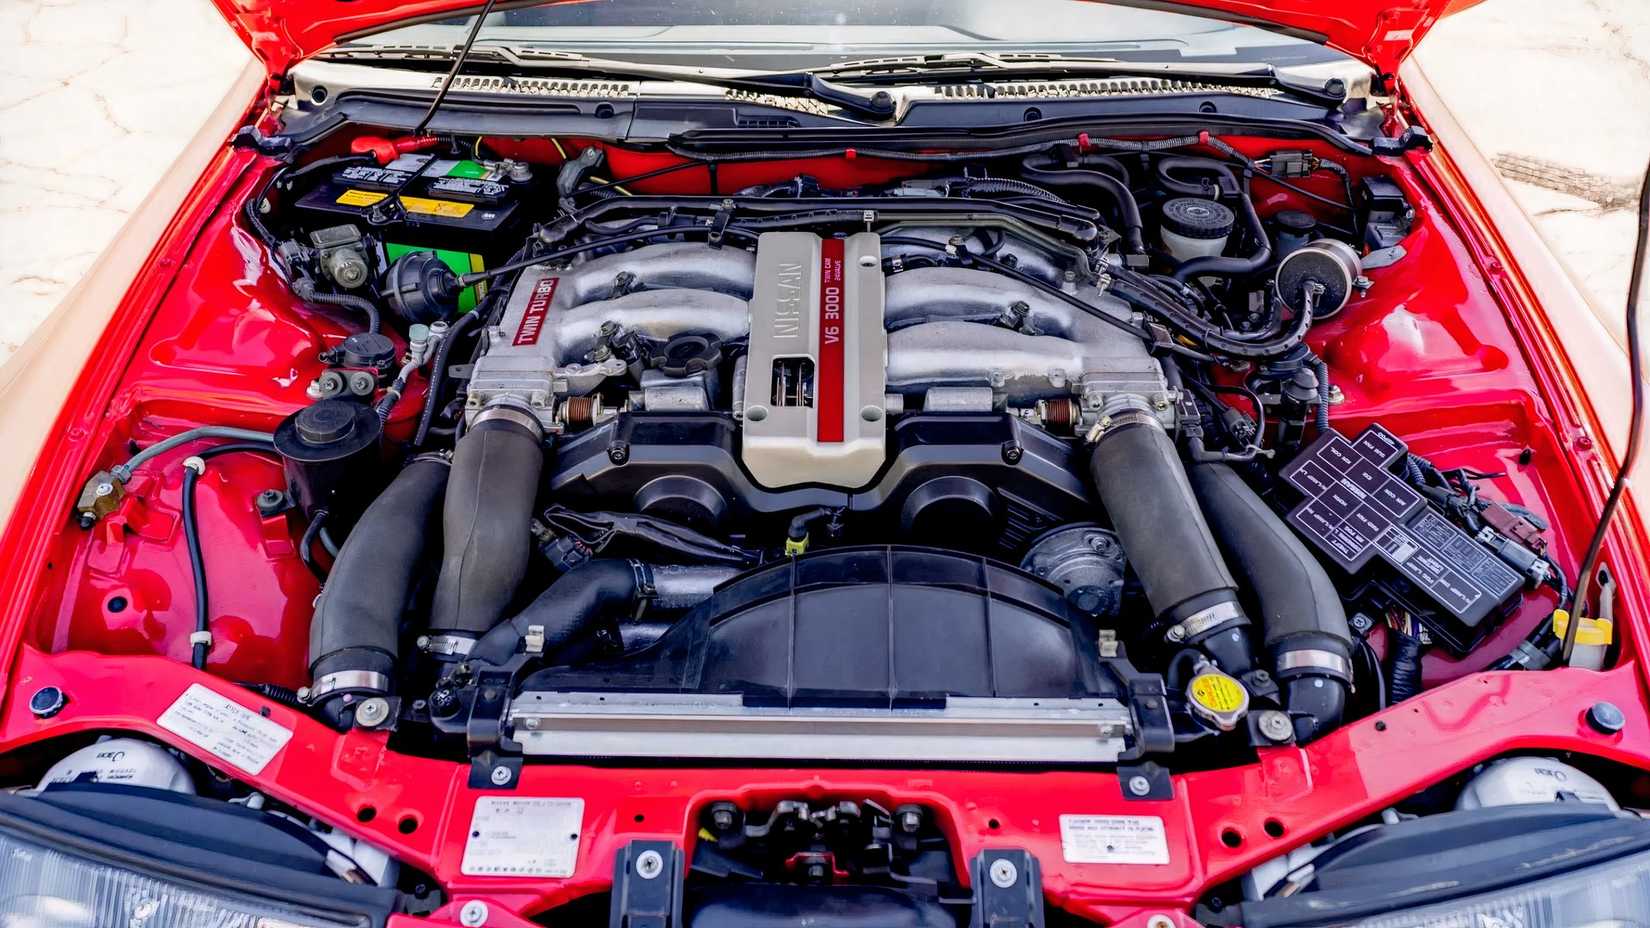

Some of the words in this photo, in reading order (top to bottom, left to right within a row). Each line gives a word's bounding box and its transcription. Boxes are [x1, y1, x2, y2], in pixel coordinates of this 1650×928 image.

[528, 279, 555, 314] TURBO
[772, 263, 802, 338] NISSAN
[825, 287, 840, 320] 3000
[517, 315, 542, 344] TWIN
[825, 326, 840, 345] V6
[1340, 478, 1367, 499] NISSAN
